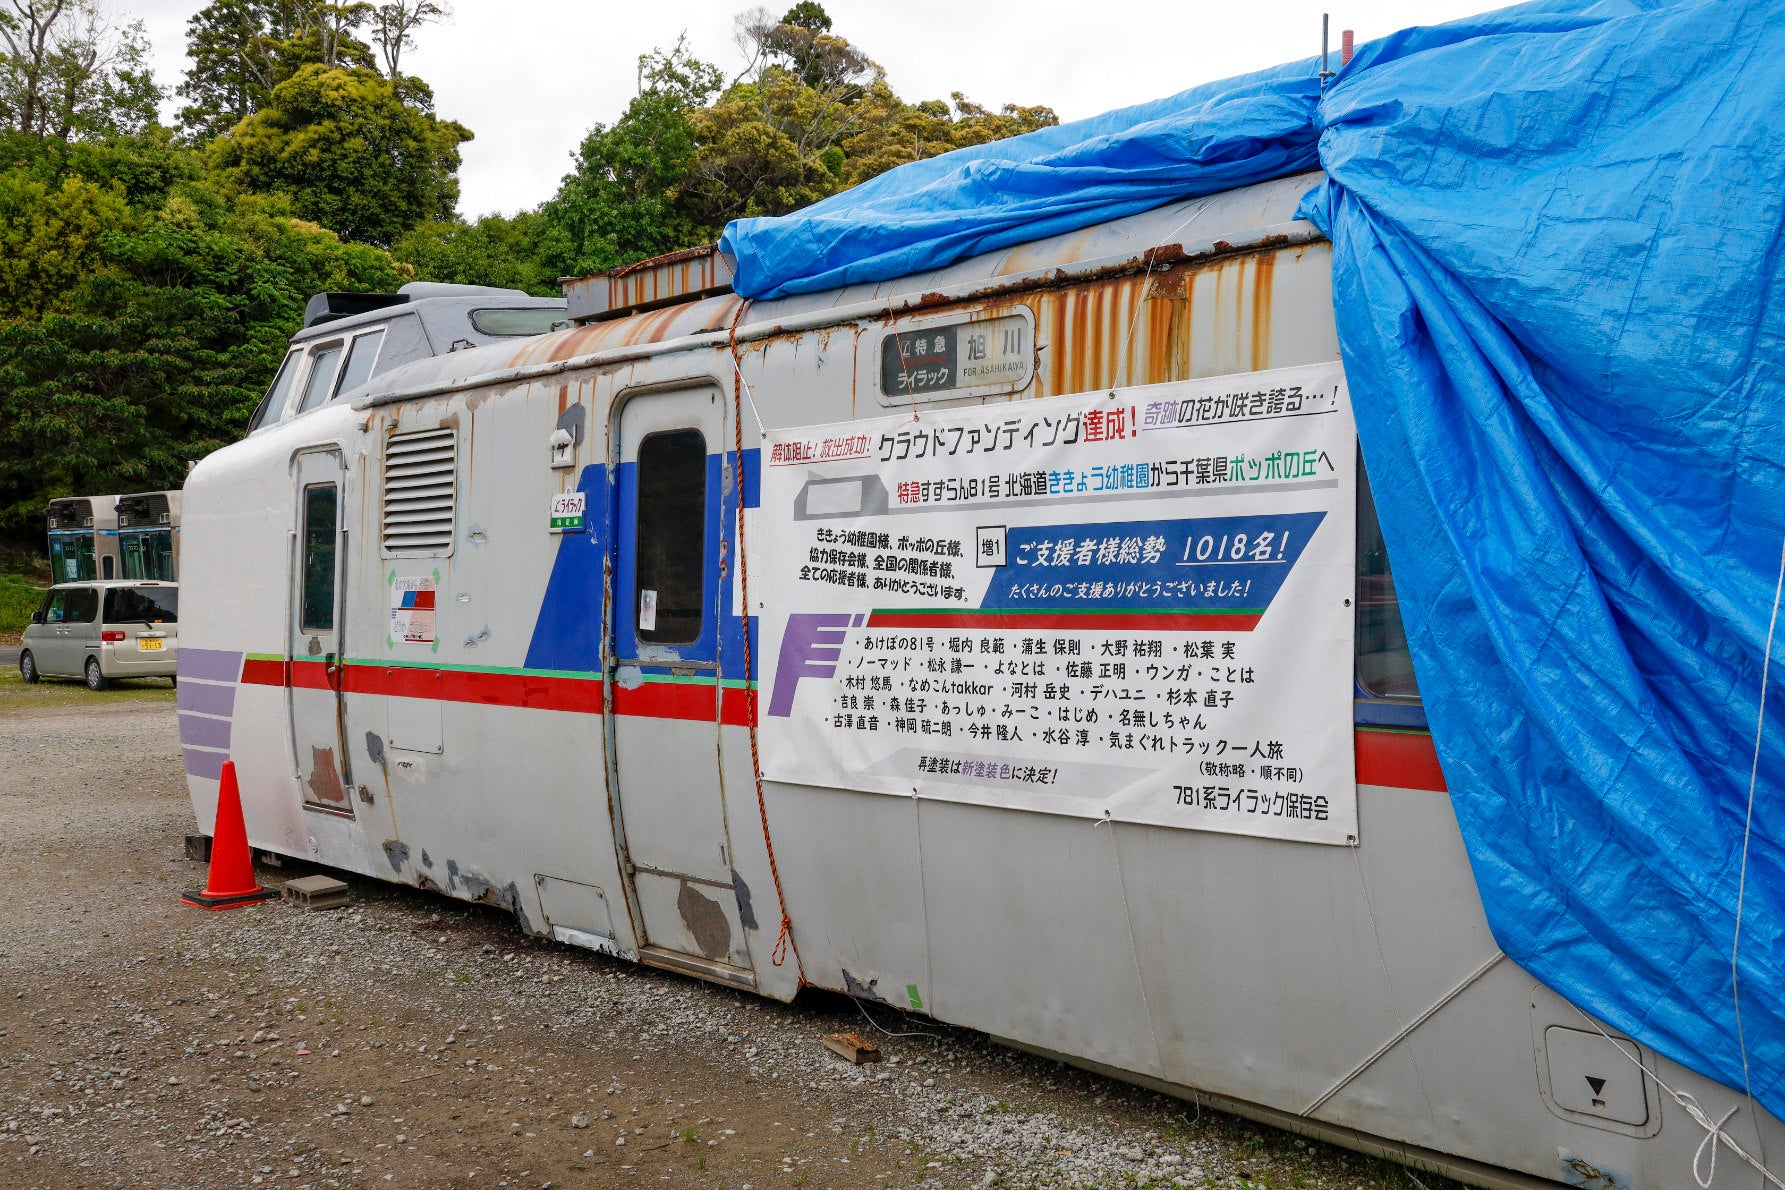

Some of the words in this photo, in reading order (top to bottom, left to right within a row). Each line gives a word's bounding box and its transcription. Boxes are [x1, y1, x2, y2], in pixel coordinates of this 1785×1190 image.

[967, 327, 1021, 361] 旭川
[897, 367, 949, 389] ライラック
[963, 368, 977, 377] FOR
[980, 361, 1024, 374] ASAHIKAWA
[981, 539, 1001, 556] 増1
[1016, 535, 1166, 567] ご支援者様総勢
[1183, 530, 1290, 562] 1018名!
[1173, 785, 1329, 821] 781系ライラック保存会
